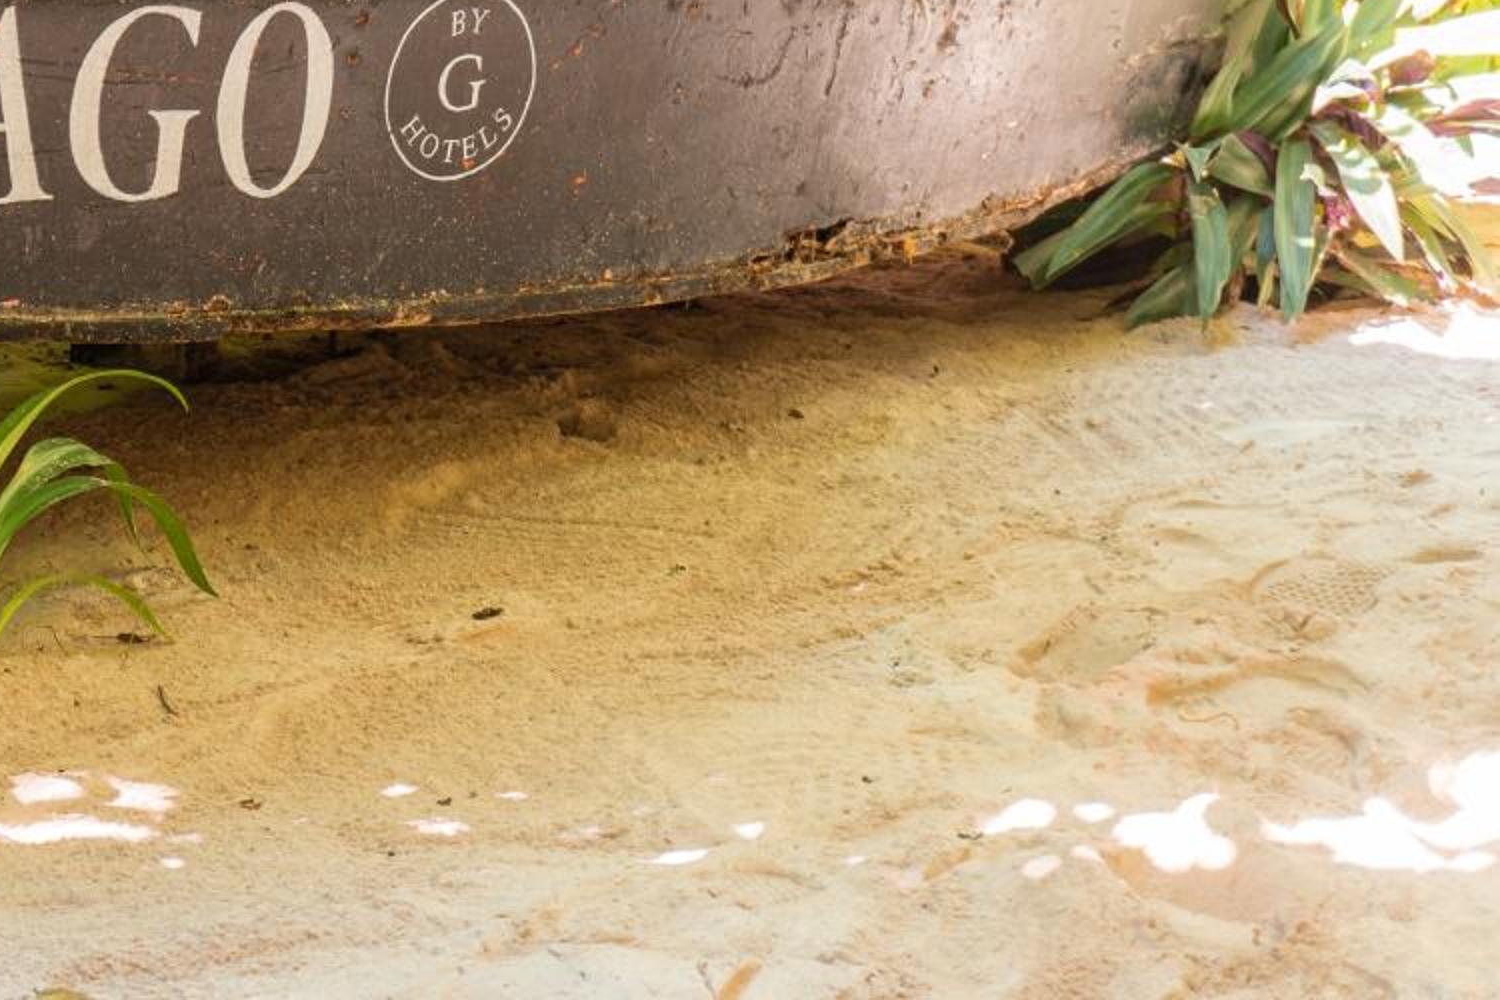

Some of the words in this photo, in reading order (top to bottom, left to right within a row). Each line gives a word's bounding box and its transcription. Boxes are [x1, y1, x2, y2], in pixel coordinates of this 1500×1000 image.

[451, 7, 491, 37] BY
[438, 53, 486, 112] G
[400, 107, 512, 163] HOTELS
